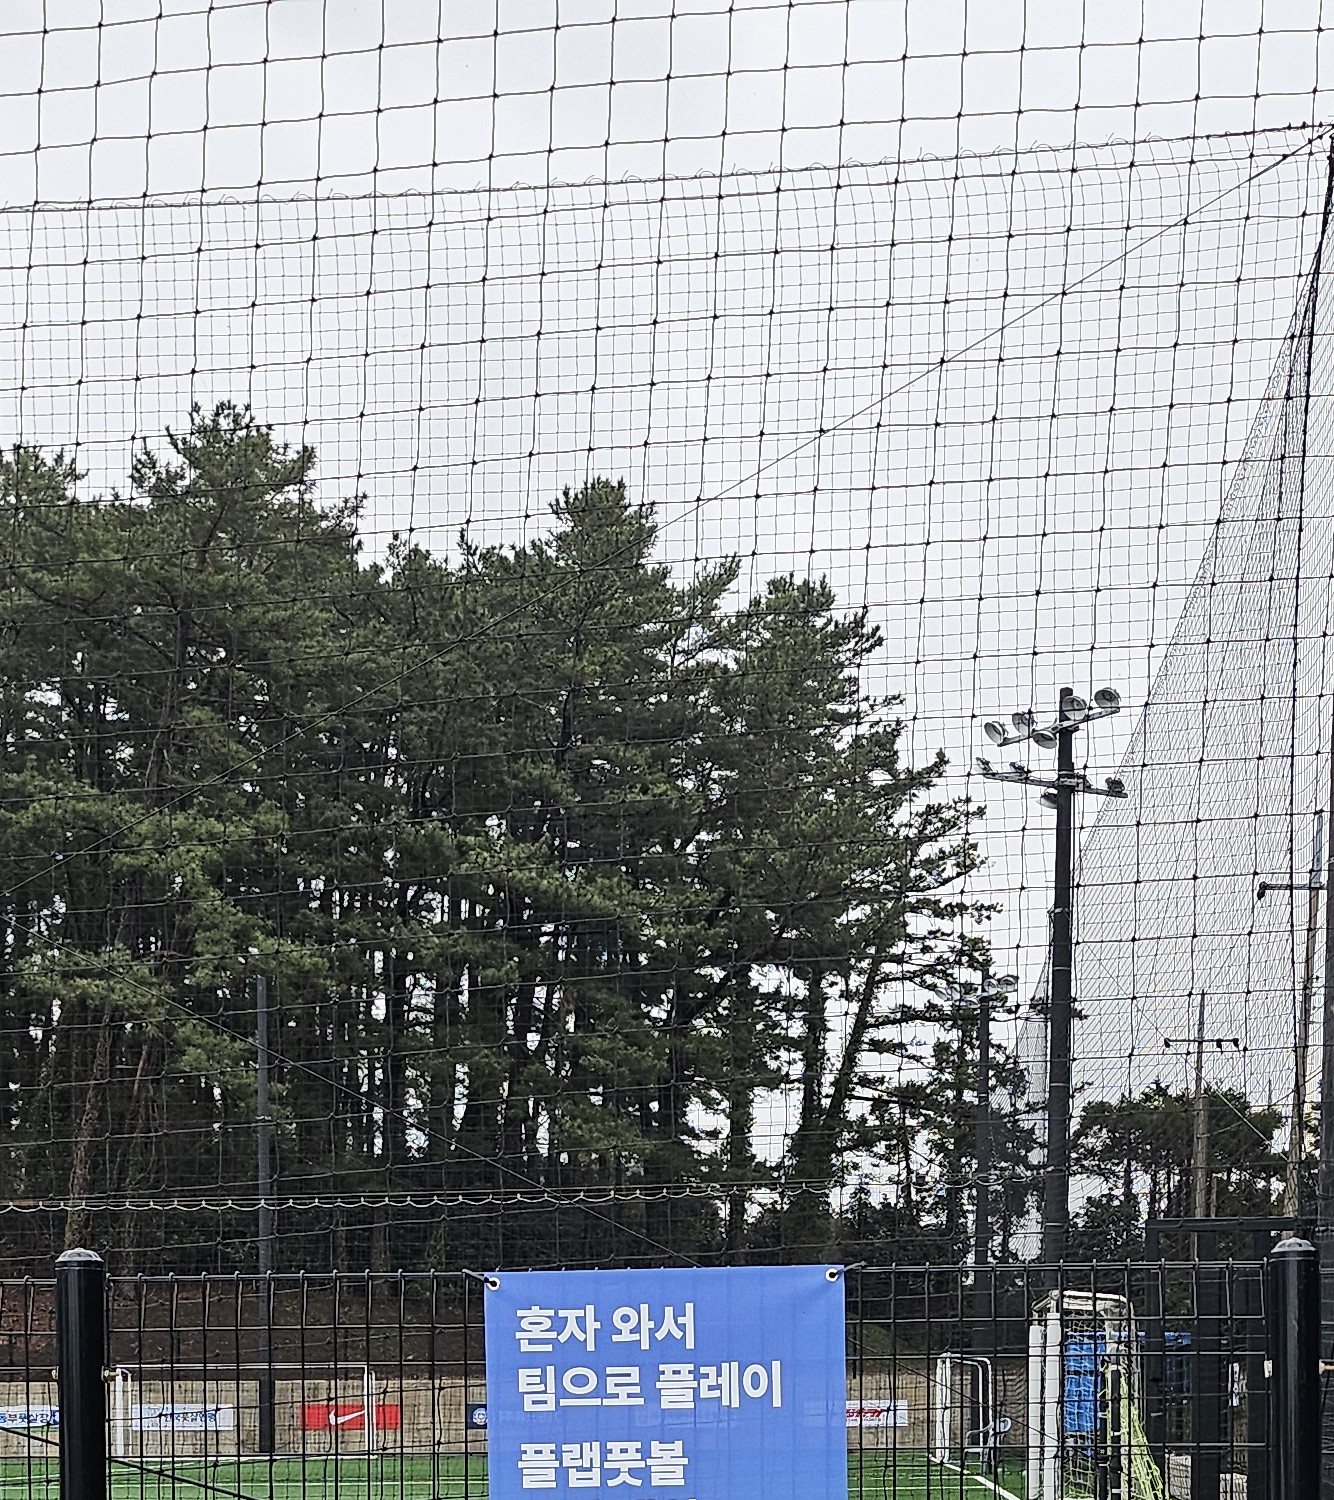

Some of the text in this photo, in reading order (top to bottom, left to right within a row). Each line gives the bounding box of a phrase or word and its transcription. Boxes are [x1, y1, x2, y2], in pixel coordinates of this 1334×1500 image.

[516, 1303, 695, 1352] 혼자 와서
[518, 1360, 782, 1412] 팀으로 플레이
[517, 1440, 689, 1489] 플랩풋볼
